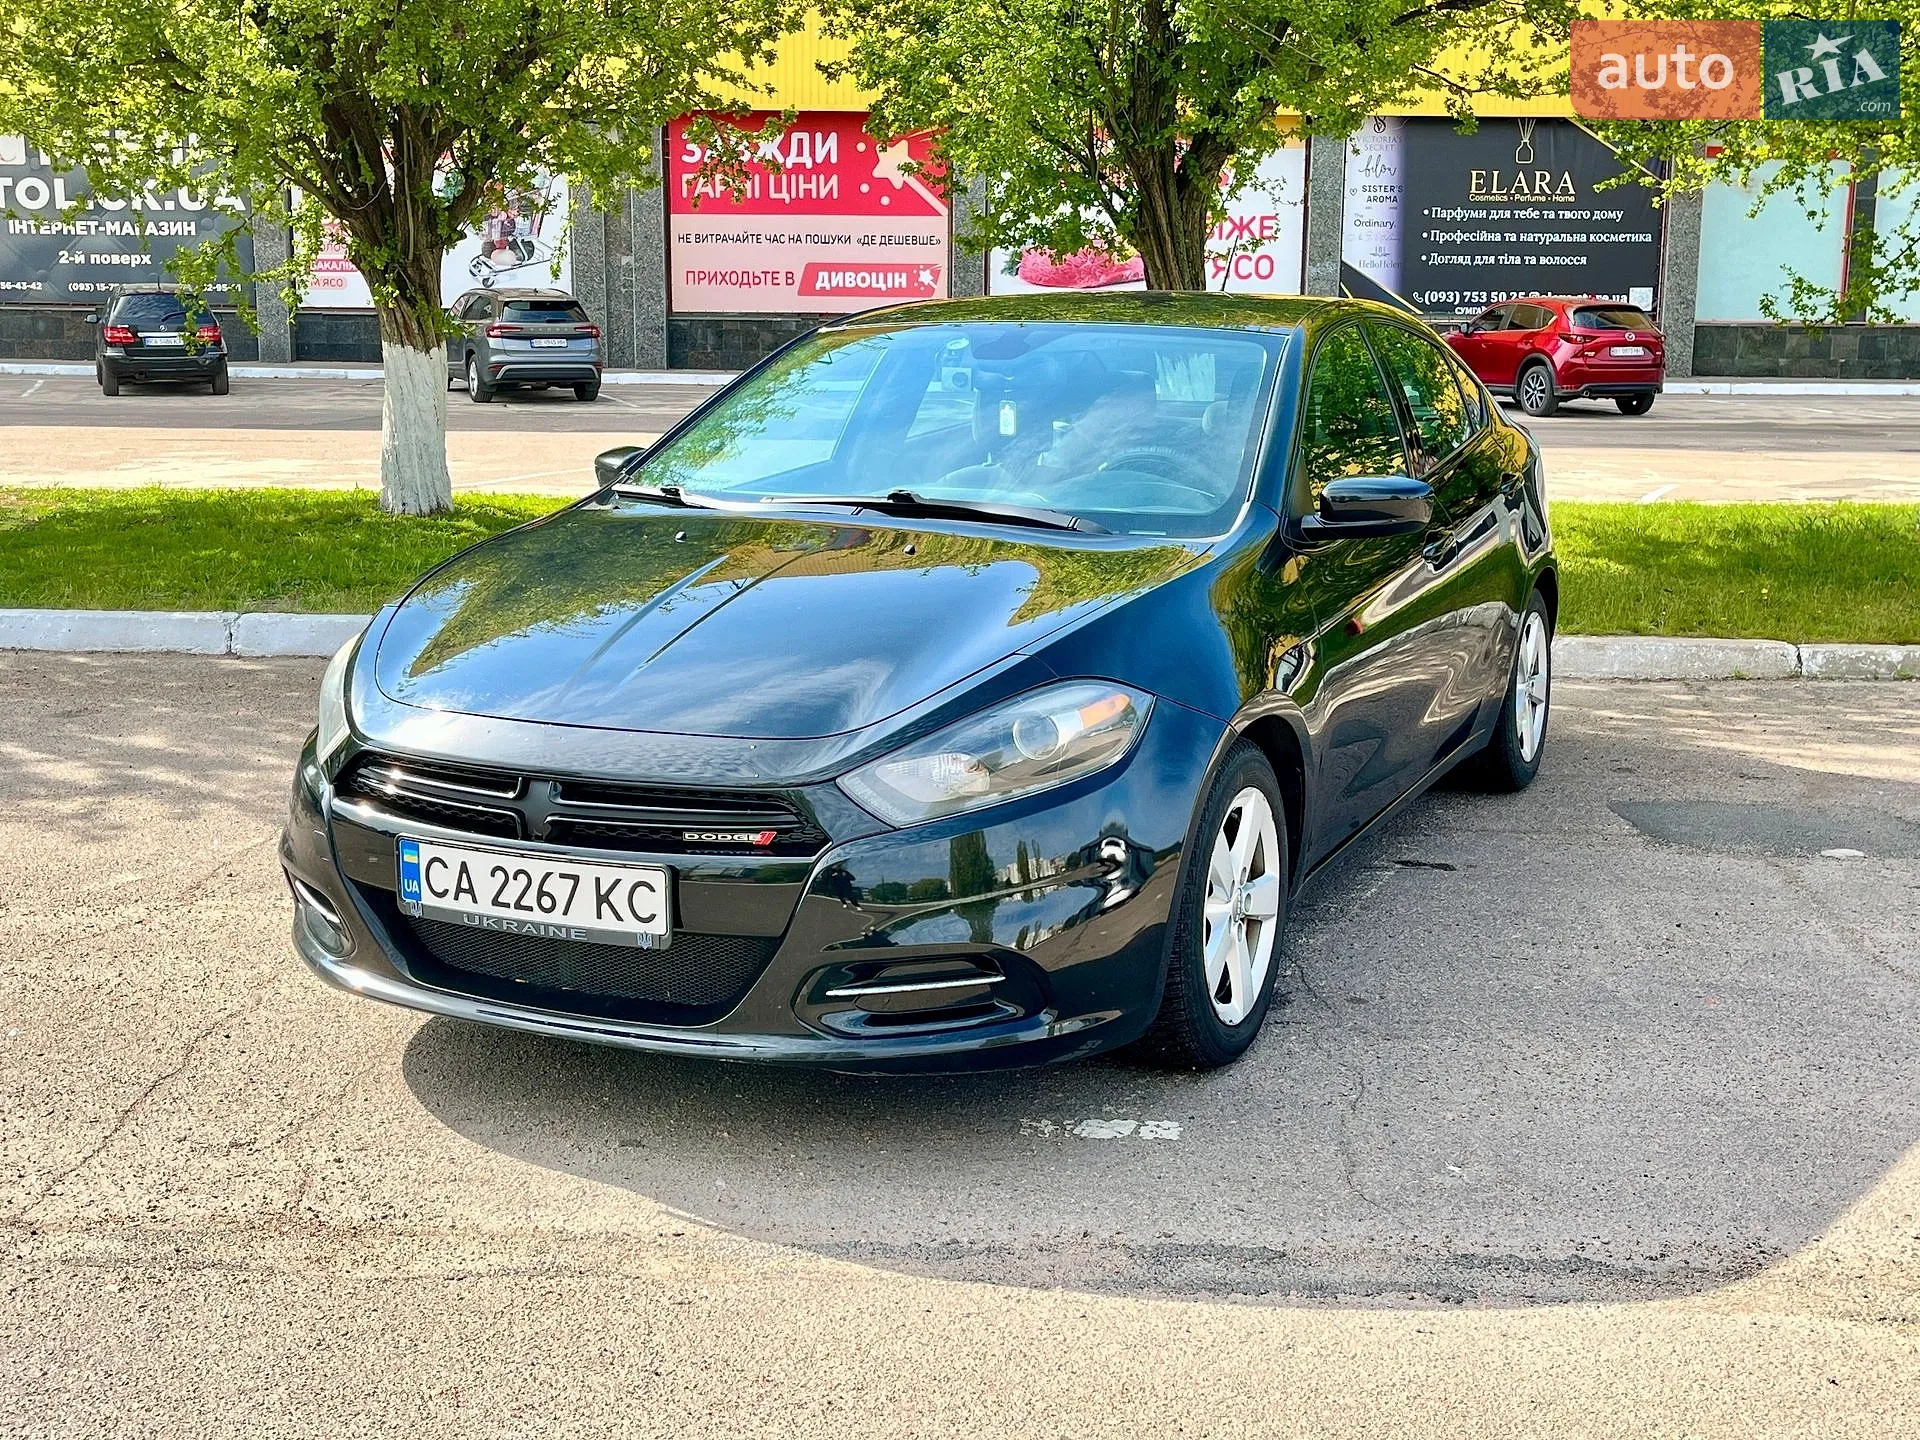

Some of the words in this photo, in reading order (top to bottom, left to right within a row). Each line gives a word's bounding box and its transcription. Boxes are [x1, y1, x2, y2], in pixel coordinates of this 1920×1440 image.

[769, 173, 839, 204] ЦІНИ
[1361, 184, 1404, 193] SISTER'S
[1469, 170, 1576, 194] ELARA
[1366, 195, 1399, 203] AROMA
[1469, 194, 1508, 202] Cosmetics
[1514, 194, 1546, 202] Perfume
[1552, 194, 1576, 202] Home
[1431, 207, 1487, 221] Парфуми
[1489, 210, 1511, 220] для
[1513, 208, 1540, 219] тебе
[1542, 210, 1555, 219] та
[1558, 210, 1591, 219] твого
[1592, 210, 1624, 222] дому
[677, 233, 692, 244] НЕ
[694, 231, 762, 244] ВИТРАЧАЙТЕ
[764, 233, 786, 244] ЧАС
[788, 234, 803, 244] НА
[805, 234, 851, 245] ПОШУКИ
[857, 235, 877, 246] «ДЕ
[879, 235, 941, 247] ДЕШЕВШЕ»
[1430, 230, 1502, 244] Професійна
[1504, 233, 1517, 242] та
[1519, 233, 1587, 245] натуральна
[1589, 233, 1653, 243] косметика
[58, 250, 85, 265] 2-й
[90, 252, 152, 267] поверх
[1428, 253, 1472, 265] Догляд
[1473, 256, 1496, 265] для
[1498, 253, 1521, 264] тіла
[1523, 256, 1537, 264] та
[1539, 256, 1587, 265] волосся
[68, 282, 94, 292] (093)
[685, 271, 781, 288] ПРИХОДЬТЕ
[785, 271, 795, 286] В
[815, 271, 907, 291] ДИВОЦІН
[1424, 290, 1460, 305] (093)
[1463, 291, 1487, 303] 753
[1490, 291, 1507, 303] 50
[404, 878, 421, 895] UA
[425, 856, 479, 904] CA
[489, 865, 581, 917] 2267
[594, 876, 657, 924] KC
[462, 913, 588, 940] UKRAINE
